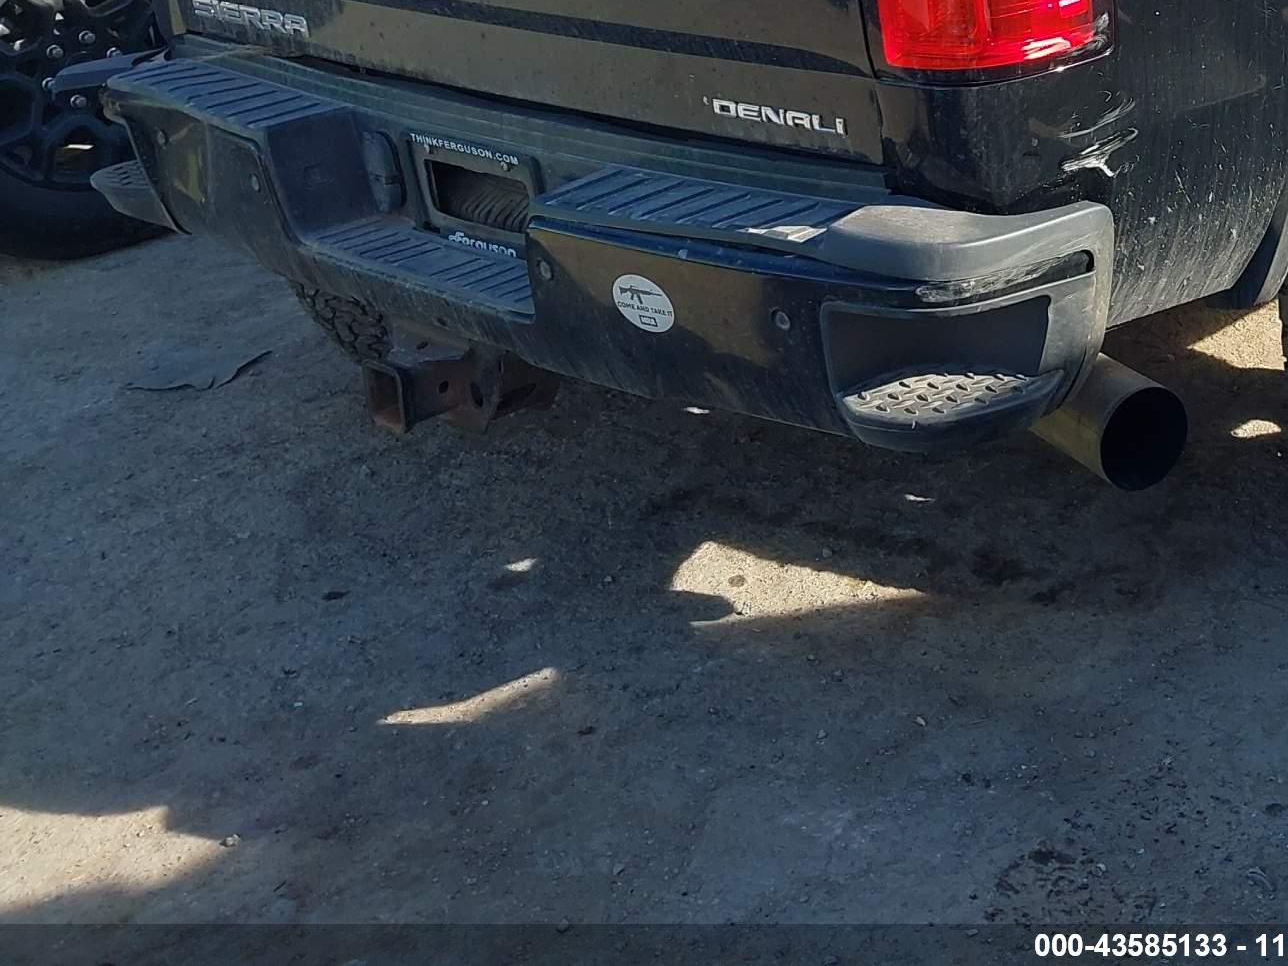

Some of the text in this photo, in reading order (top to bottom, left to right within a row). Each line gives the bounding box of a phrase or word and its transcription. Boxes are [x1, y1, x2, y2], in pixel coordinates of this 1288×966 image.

[712, 98, 848, 136] DENALI
[409, 133, 519, 165] THINKFERGUSON.COM
[636, 304, 650, 313] AND
[650, 307, 667, 316] TAKE
